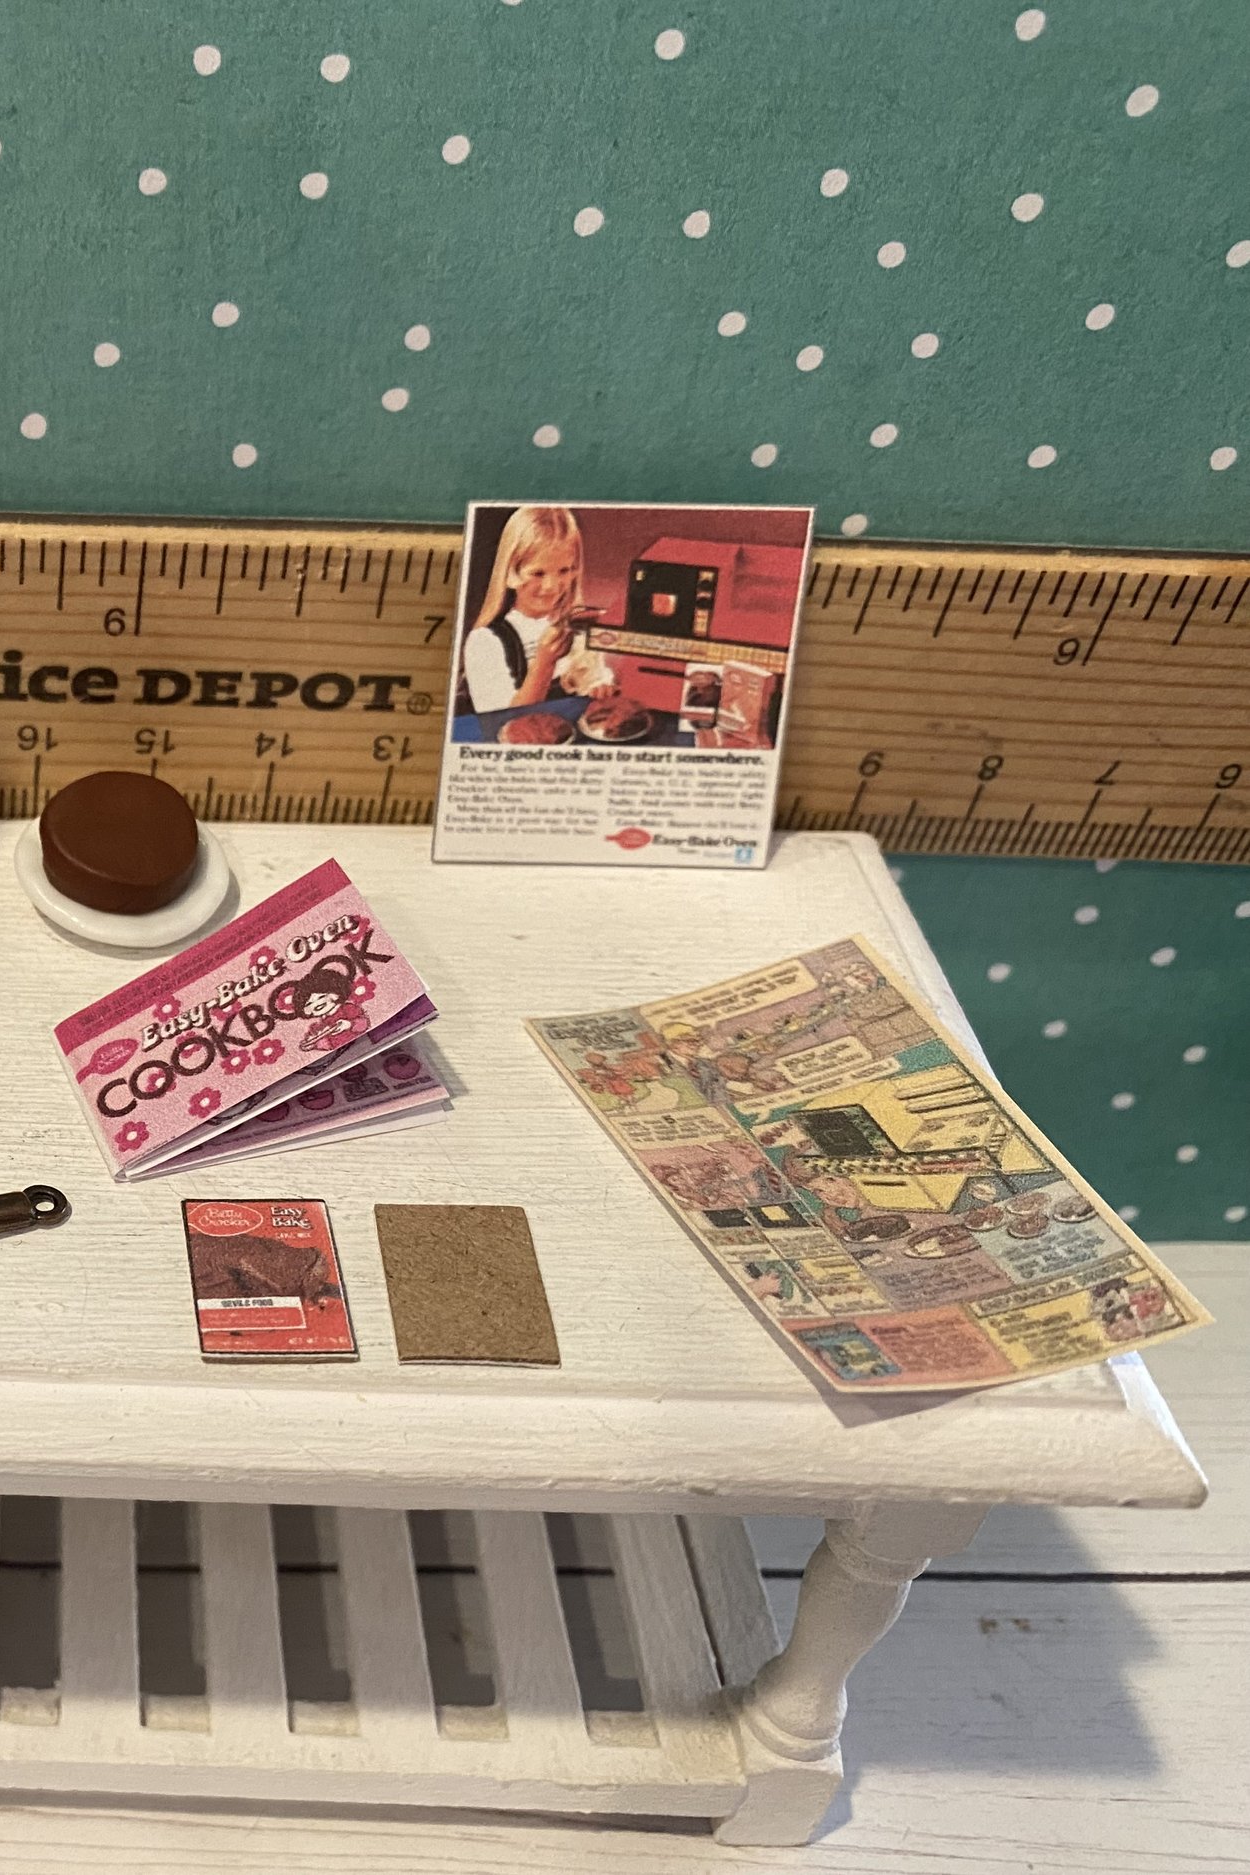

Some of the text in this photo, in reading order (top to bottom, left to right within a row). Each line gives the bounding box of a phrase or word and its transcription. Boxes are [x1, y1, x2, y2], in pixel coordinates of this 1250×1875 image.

[103, 608, 127, 637] 6
[423, 615, 446, 643] 7
[16, 725, 59, 751] 16
[134, 727, 176, 755] 15
[254, 732, 294, 759] 14
[372, 734, 415, 761] 13
[459, 746, 503, 761] Every
[504, 748, 544, 762] good
[546, 748, 583, 760] cook
[587, 749, 612, 761] has
[616, 751, 632, 762] to
[634, 751, 672, 762] start
[140, 960, 287, 1052] Easy-Bake
[284, 914, 359, 963] Oven
[95, 928, 395, 1119] COOKBOOK
[271, 1217, 313, 1229] Bake
